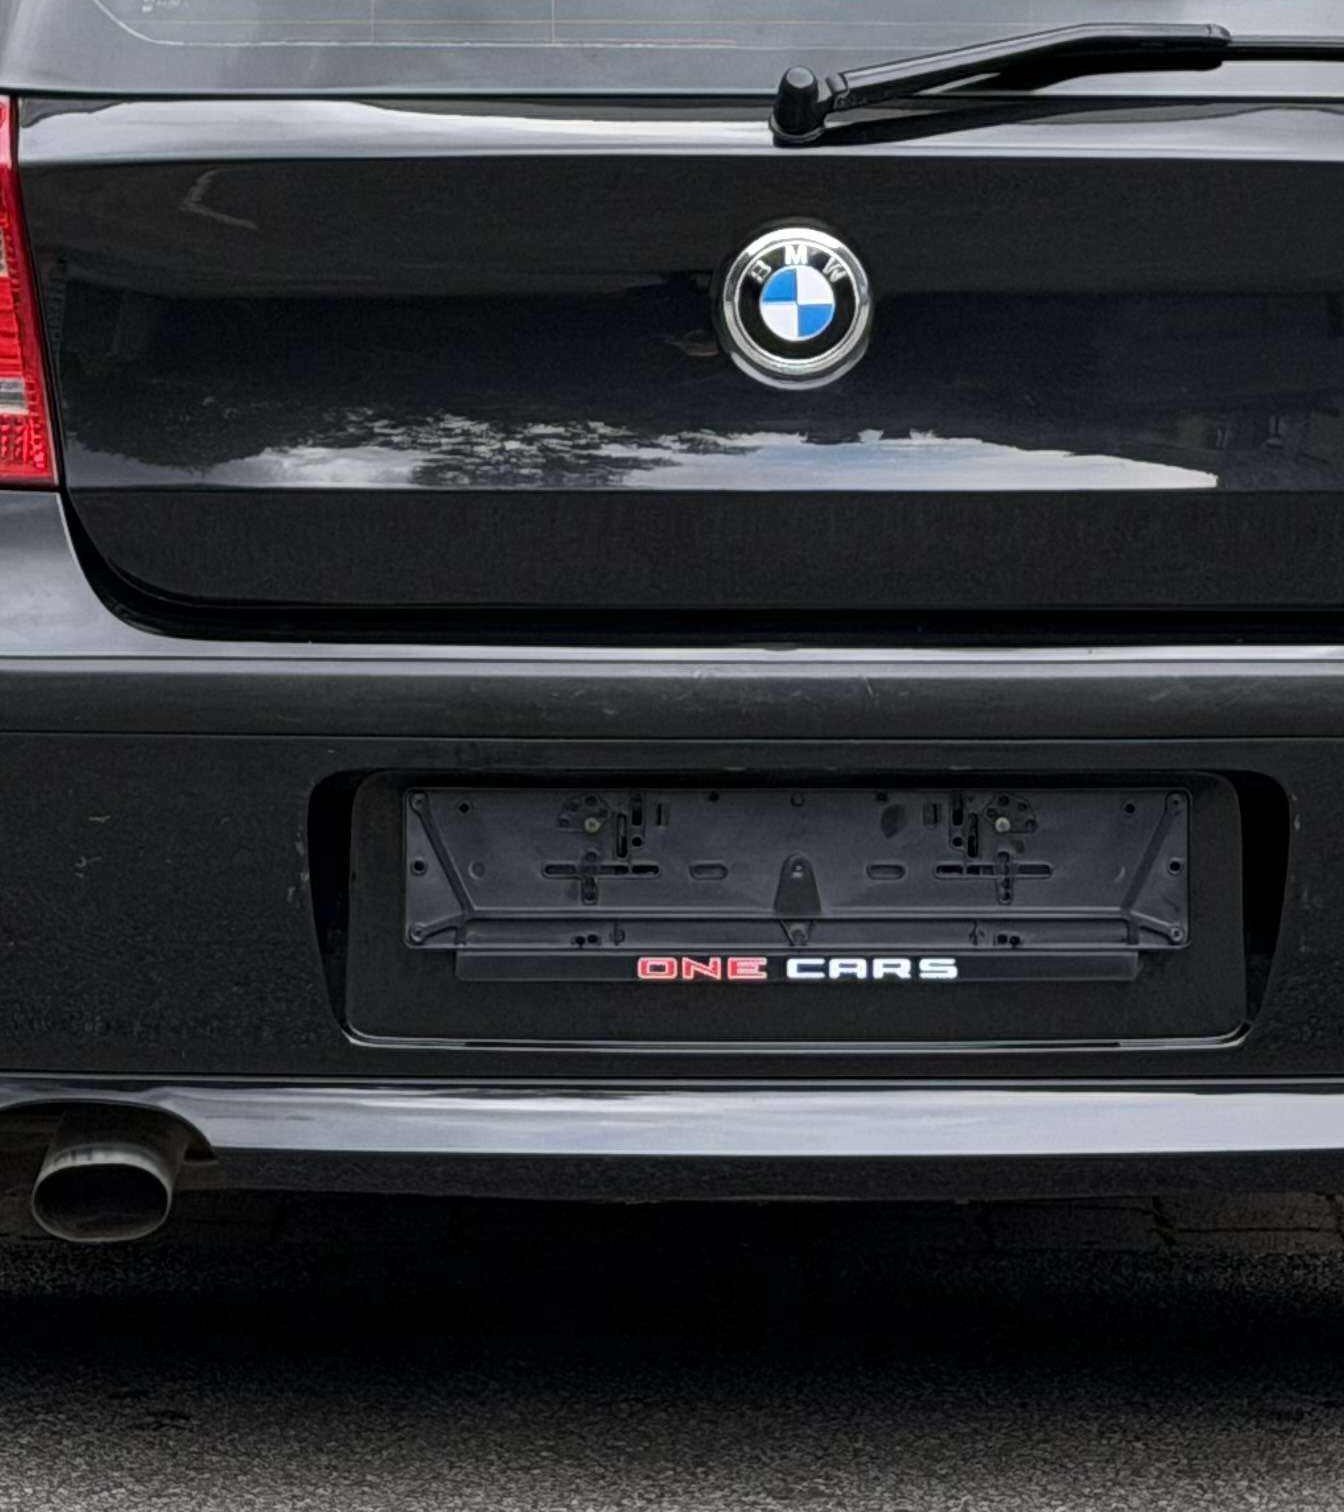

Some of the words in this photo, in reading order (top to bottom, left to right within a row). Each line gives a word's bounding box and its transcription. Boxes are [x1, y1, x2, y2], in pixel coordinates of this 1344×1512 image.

[749, 243, 847, 284] BMW
[637, 957, 768, 980] ONE
[786, 957, 958, 980] CARS
